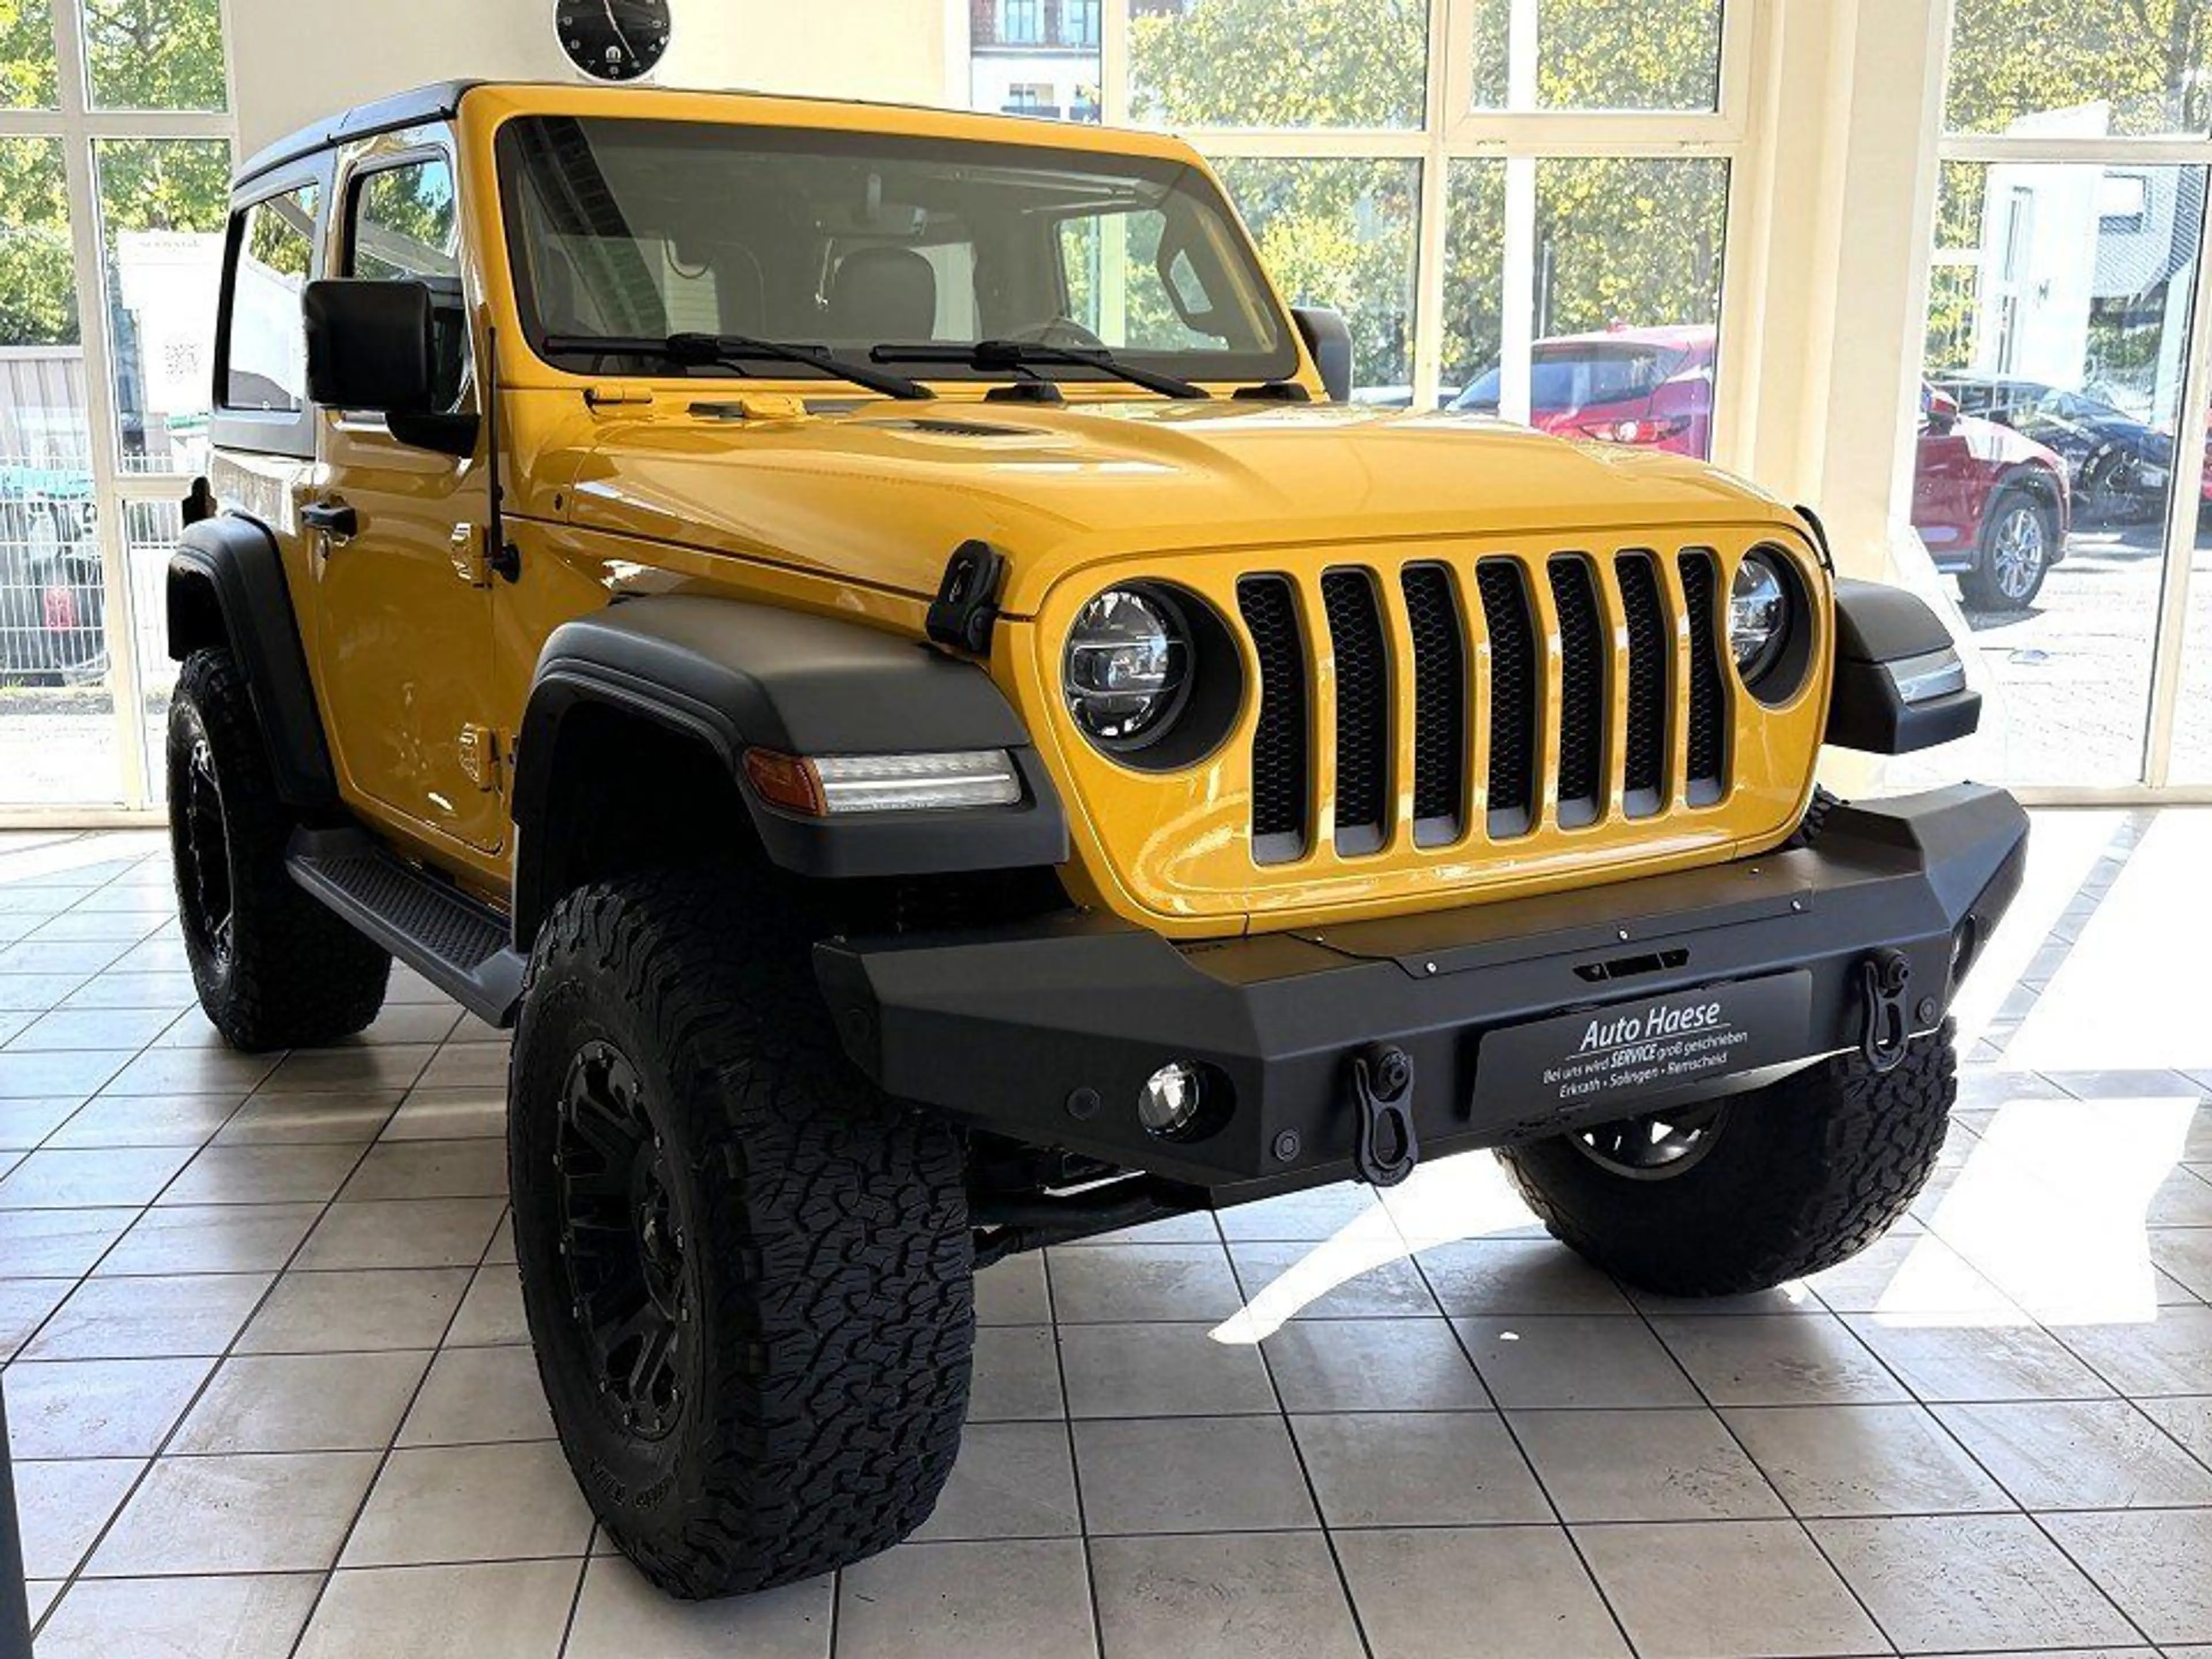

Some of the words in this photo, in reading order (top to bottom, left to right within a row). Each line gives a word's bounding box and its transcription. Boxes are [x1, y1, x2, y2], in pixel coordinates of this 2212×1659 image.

[1580, 1016, 1639, 1051] Auto
[1645, 1002, 1720, 1037] Haese
[1543, 1069, 1562, 1084] Bei
[1562, 1067, 1582, 1080] uns
[1583, 1057, 1609, 1075] wird
[1611, 1043, 1657, 1069] SERVICE
[1684, 1031, 1748, 1058] geschrieben
[1559, 1077, 1600, 1098] Erkrath
[1609, 1068, 1658, 1088] Solingen
[1667, 1052, 1727, 1074] Remscheid
